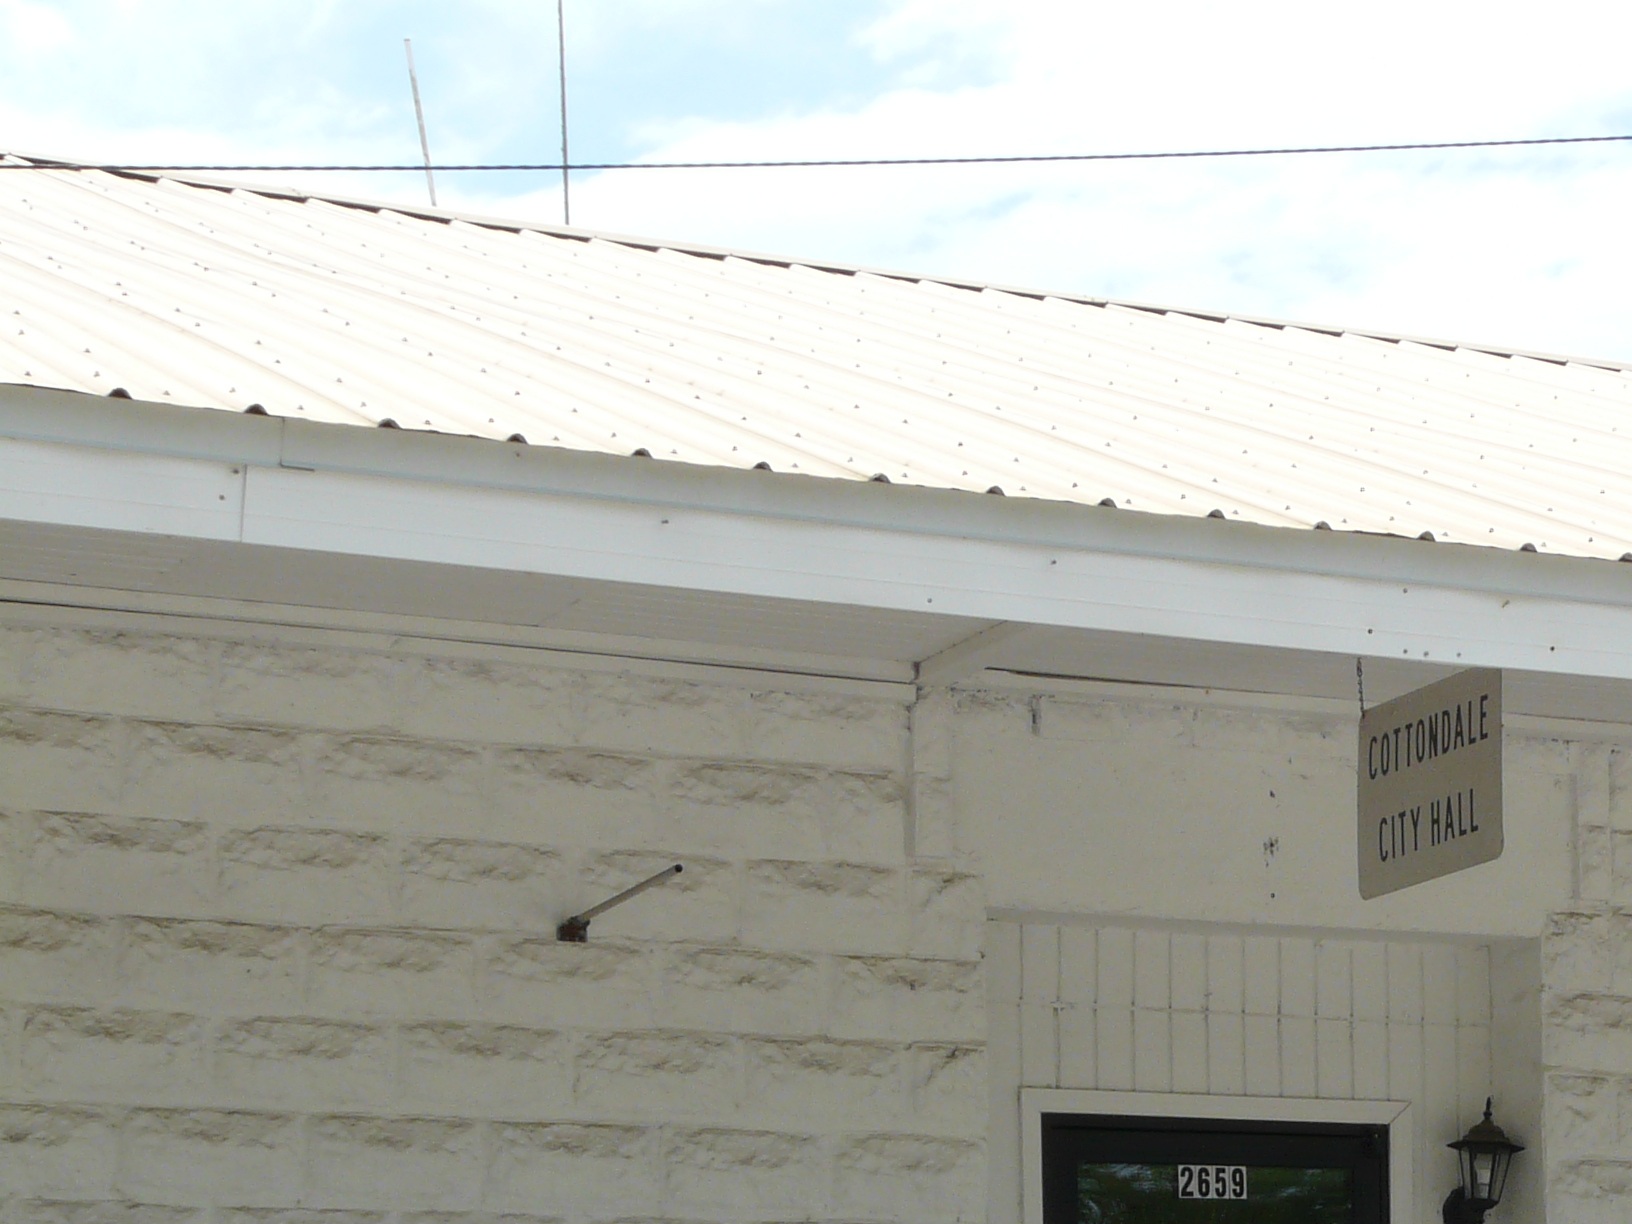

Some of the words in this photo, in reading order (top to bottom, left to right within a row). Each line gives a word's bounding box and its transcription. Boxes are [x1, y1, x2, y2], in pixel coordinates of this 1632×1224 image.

[1369, 694, 1488, 780] COTTONDALE
[1379, 806, 1421, 862] CITY
[1431, 788, 1479, 847] HALL
[1180, 1166, 1245, 1197] 2659
